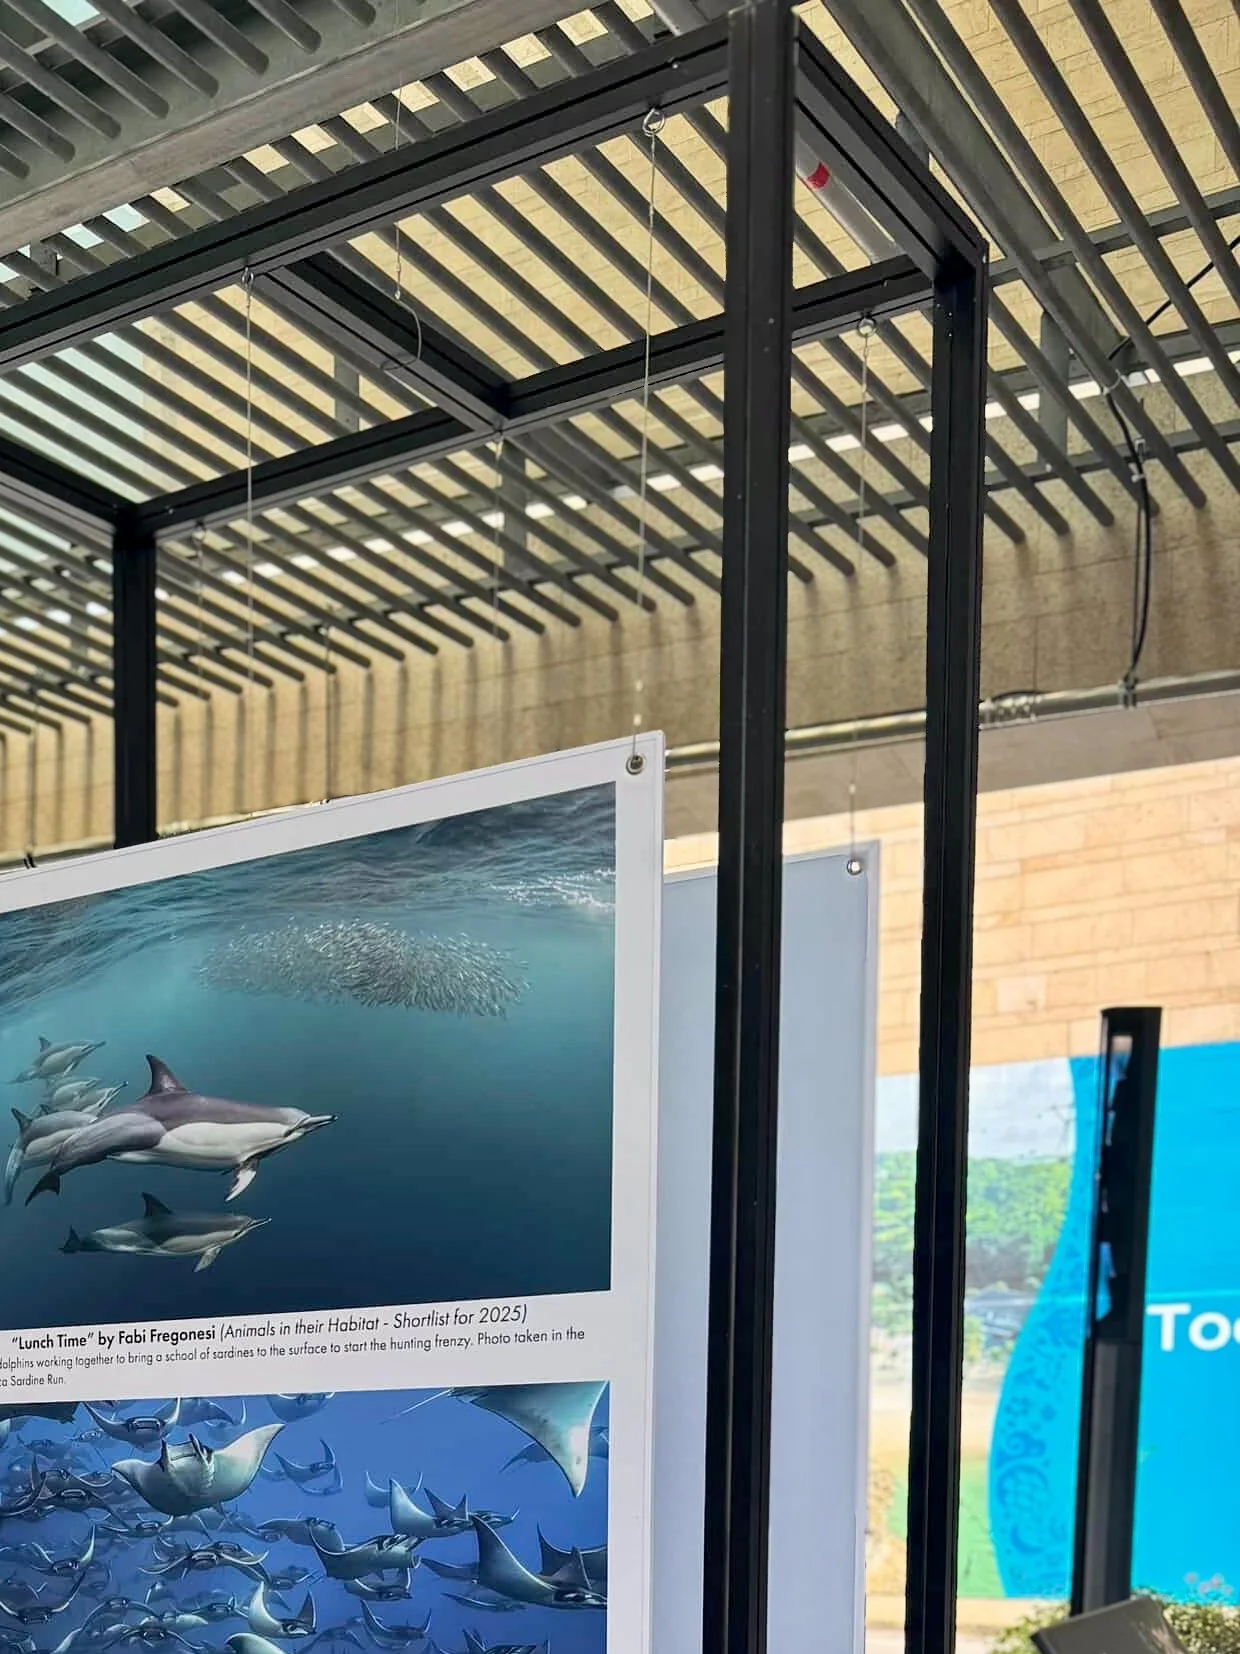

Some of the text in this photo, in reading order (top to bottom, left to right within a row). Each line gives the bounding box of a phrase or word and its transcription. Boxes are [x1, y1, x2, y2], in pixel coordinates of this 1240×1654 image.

[36, 1355, 72, 1370] working
[76, 1352, 113, 1368] together
[116, 1354, 127, 1364] to
[128, 1352, 153, 1365] bring
[156, 1354, 162, 1362] a
[166, 1348, 197, 1362] school
[200, 1346, 210, 1360] of
[213, 1345, 254, 1359] sardines
[257, 1347, 267, 1357] to
[270, 1344, 285, 1356] the
[288, 1341, 327, 1357] surface
[331, 1343, 340, 1353] to
[344, 1341, 367, 1352] start
[370, 1338, 386, 1351] the
[390, 1337, 431, 1352] hunting
[435, 1333, 474, 1350] frenzy.
[478, 1332, 511, 1345] Photo
[514, 1329, 547, 1344] taken
[552, 1329, 562, 1341] in
[567, 1326, 584, 1340] the
[98, 1331, 115, 1349] by
[119, 1329, 146, 1344] Fabi
[150, 1325, 215, 1346] Fregonesi
[221, 1320, 276, 1342] (Animals
[280, 1322, 290, 1336] in
[295, 1318, 324, 1334] their
[328, 1315, 379, 1334] Habitat
[392, 1309, 450, 1328] Shortlist
[454, 1308, 475, 1325] for
[478, 1304, 527, 1327] 2025)
[1146, 1302, 1240, 1352] To
